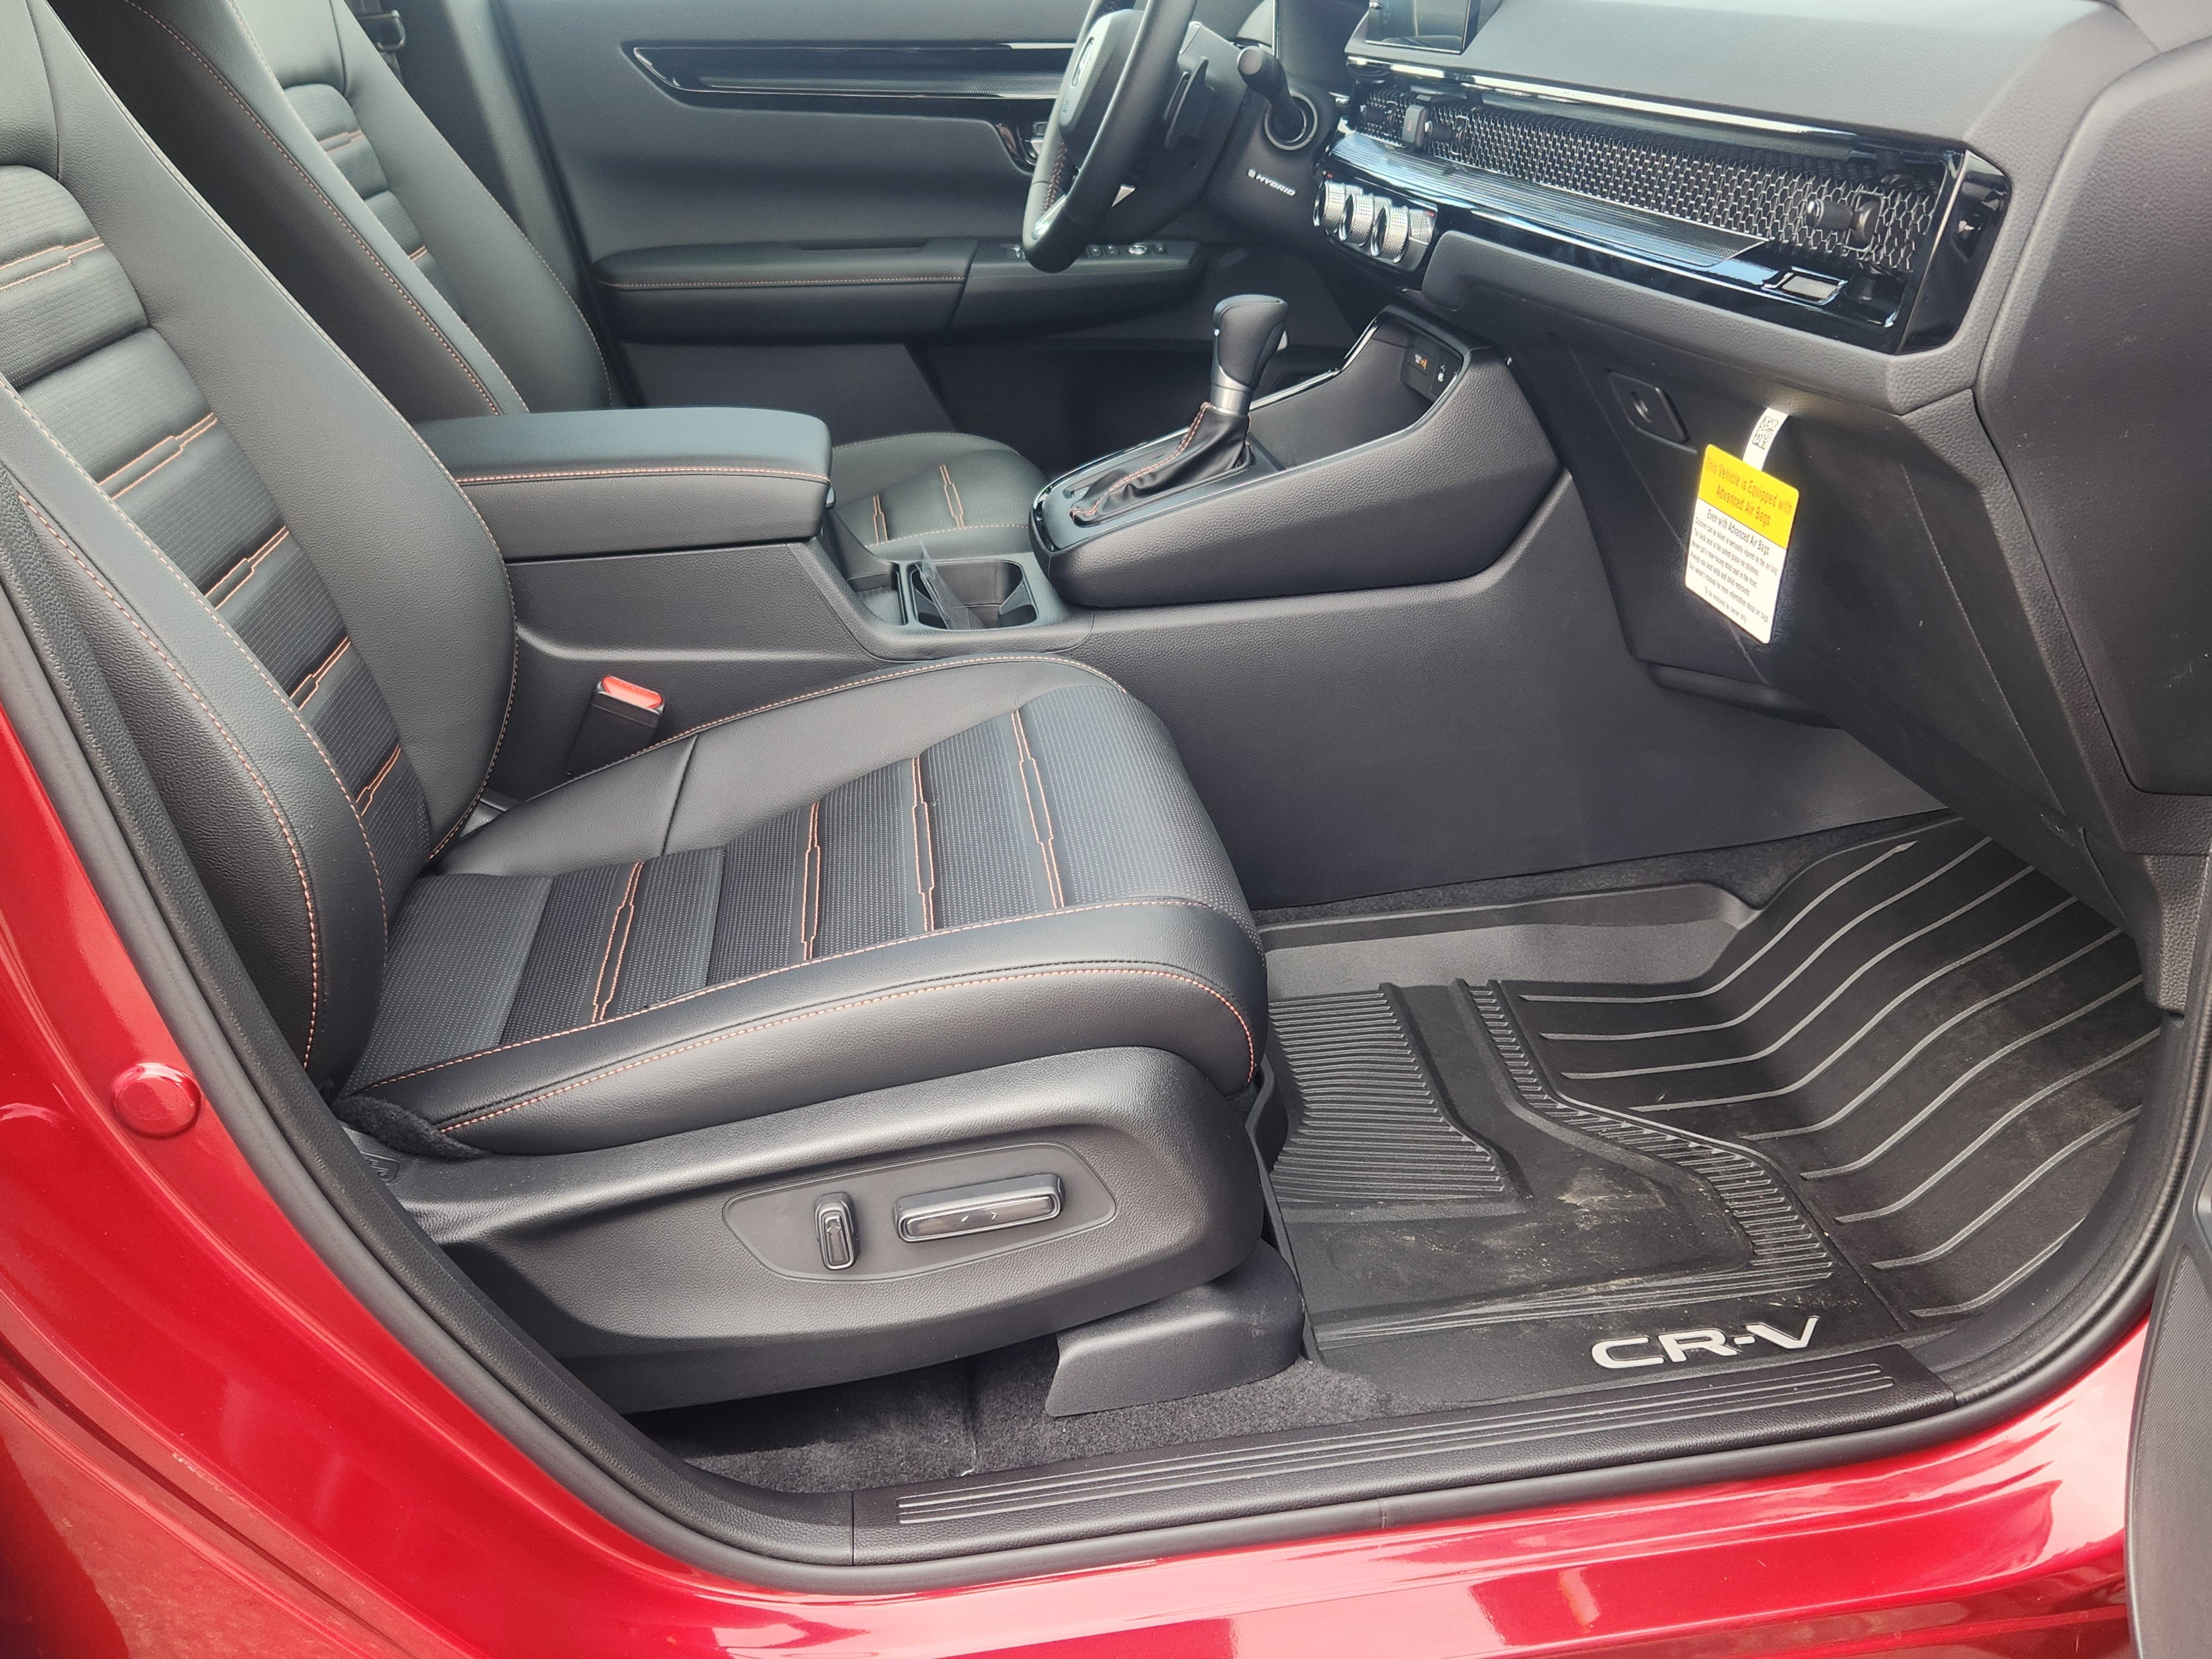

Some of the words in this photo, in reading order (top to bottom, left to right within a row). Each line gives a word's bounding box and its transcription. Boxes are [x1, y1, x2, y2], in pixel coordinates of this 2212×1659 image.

[1256, 174, 1296, 196] HYBRID
[1715, 483, 1744, 511] Advanced
[1744, 500, 1755, 517] Air
[1754, 505, 1771, 529] Bags
[1592, 1315, 1819, 1368] CR-V
